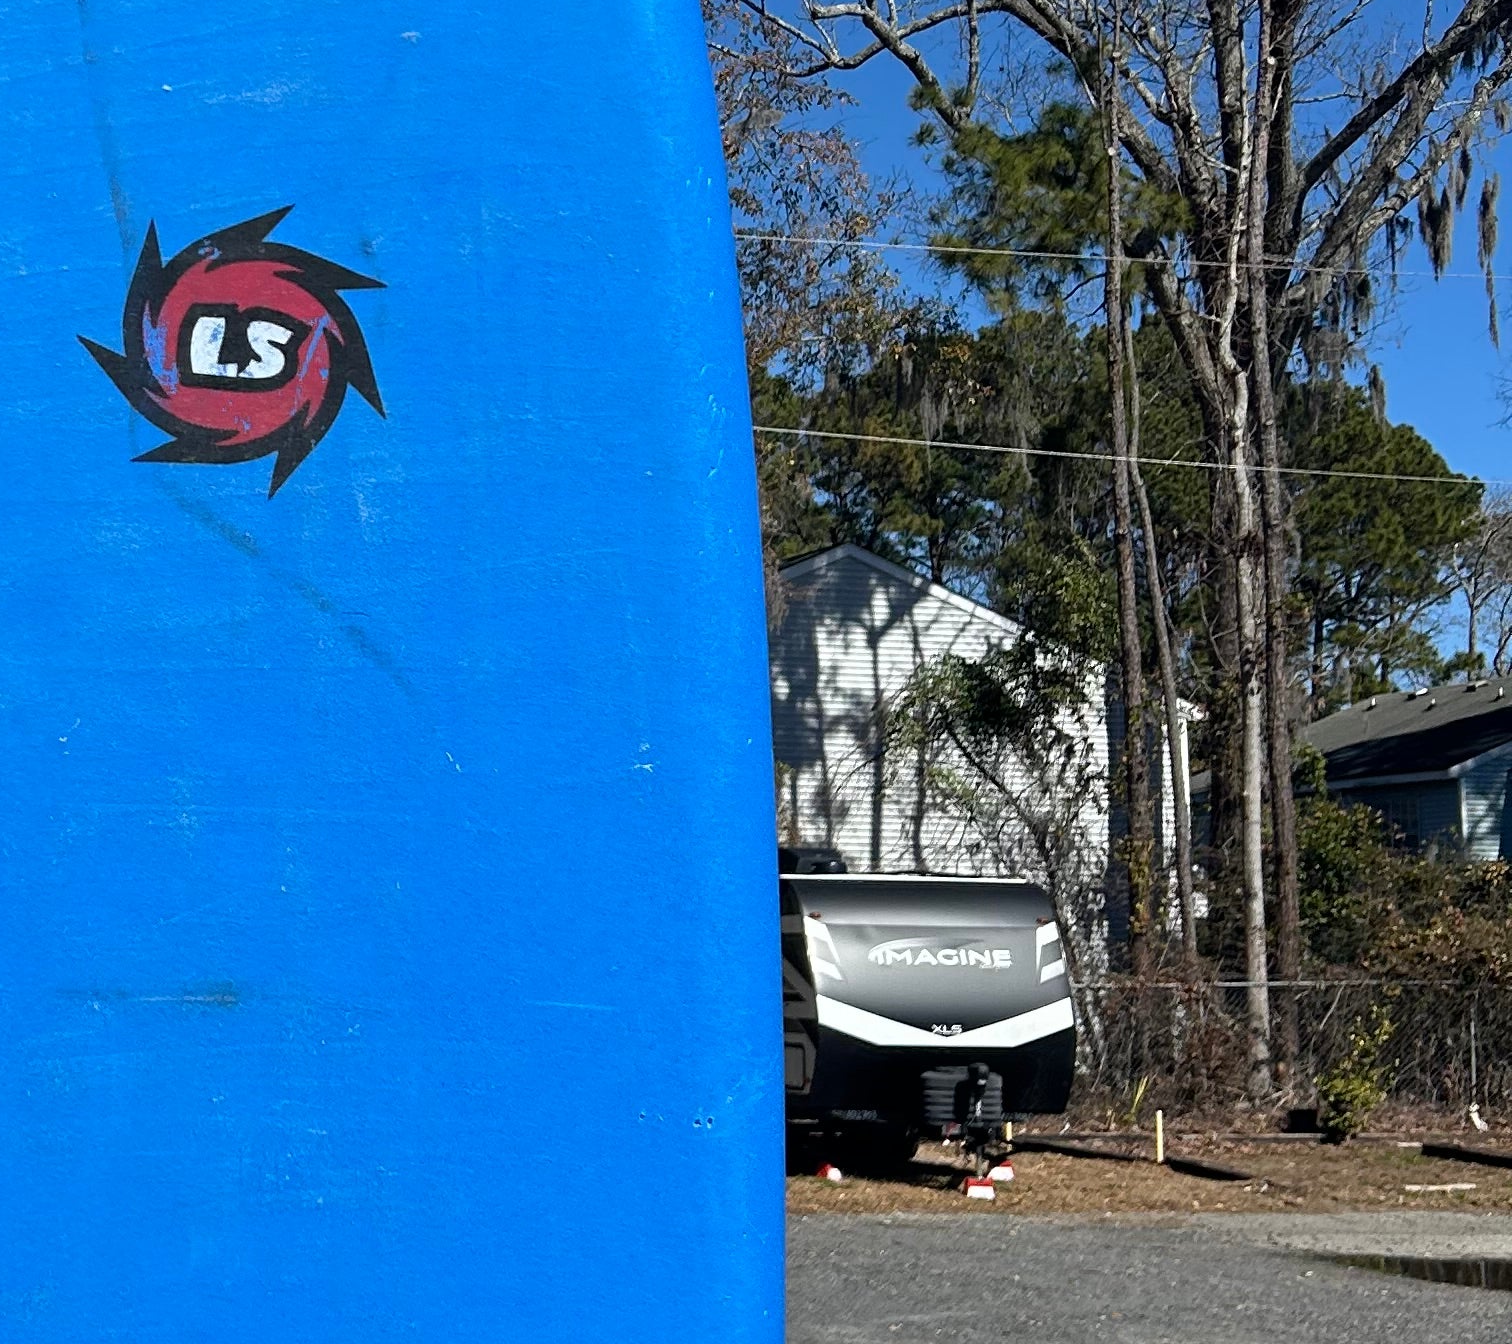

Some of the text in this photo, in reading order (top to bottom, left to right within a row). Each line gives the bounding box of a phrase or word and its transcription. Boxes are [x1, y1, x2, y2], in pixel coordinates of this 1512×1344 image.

[189, 315, 295, 380] LS
[875, 947, 1013, 969] IMAGINE
[931, 1023, 963, 1035] XLS
